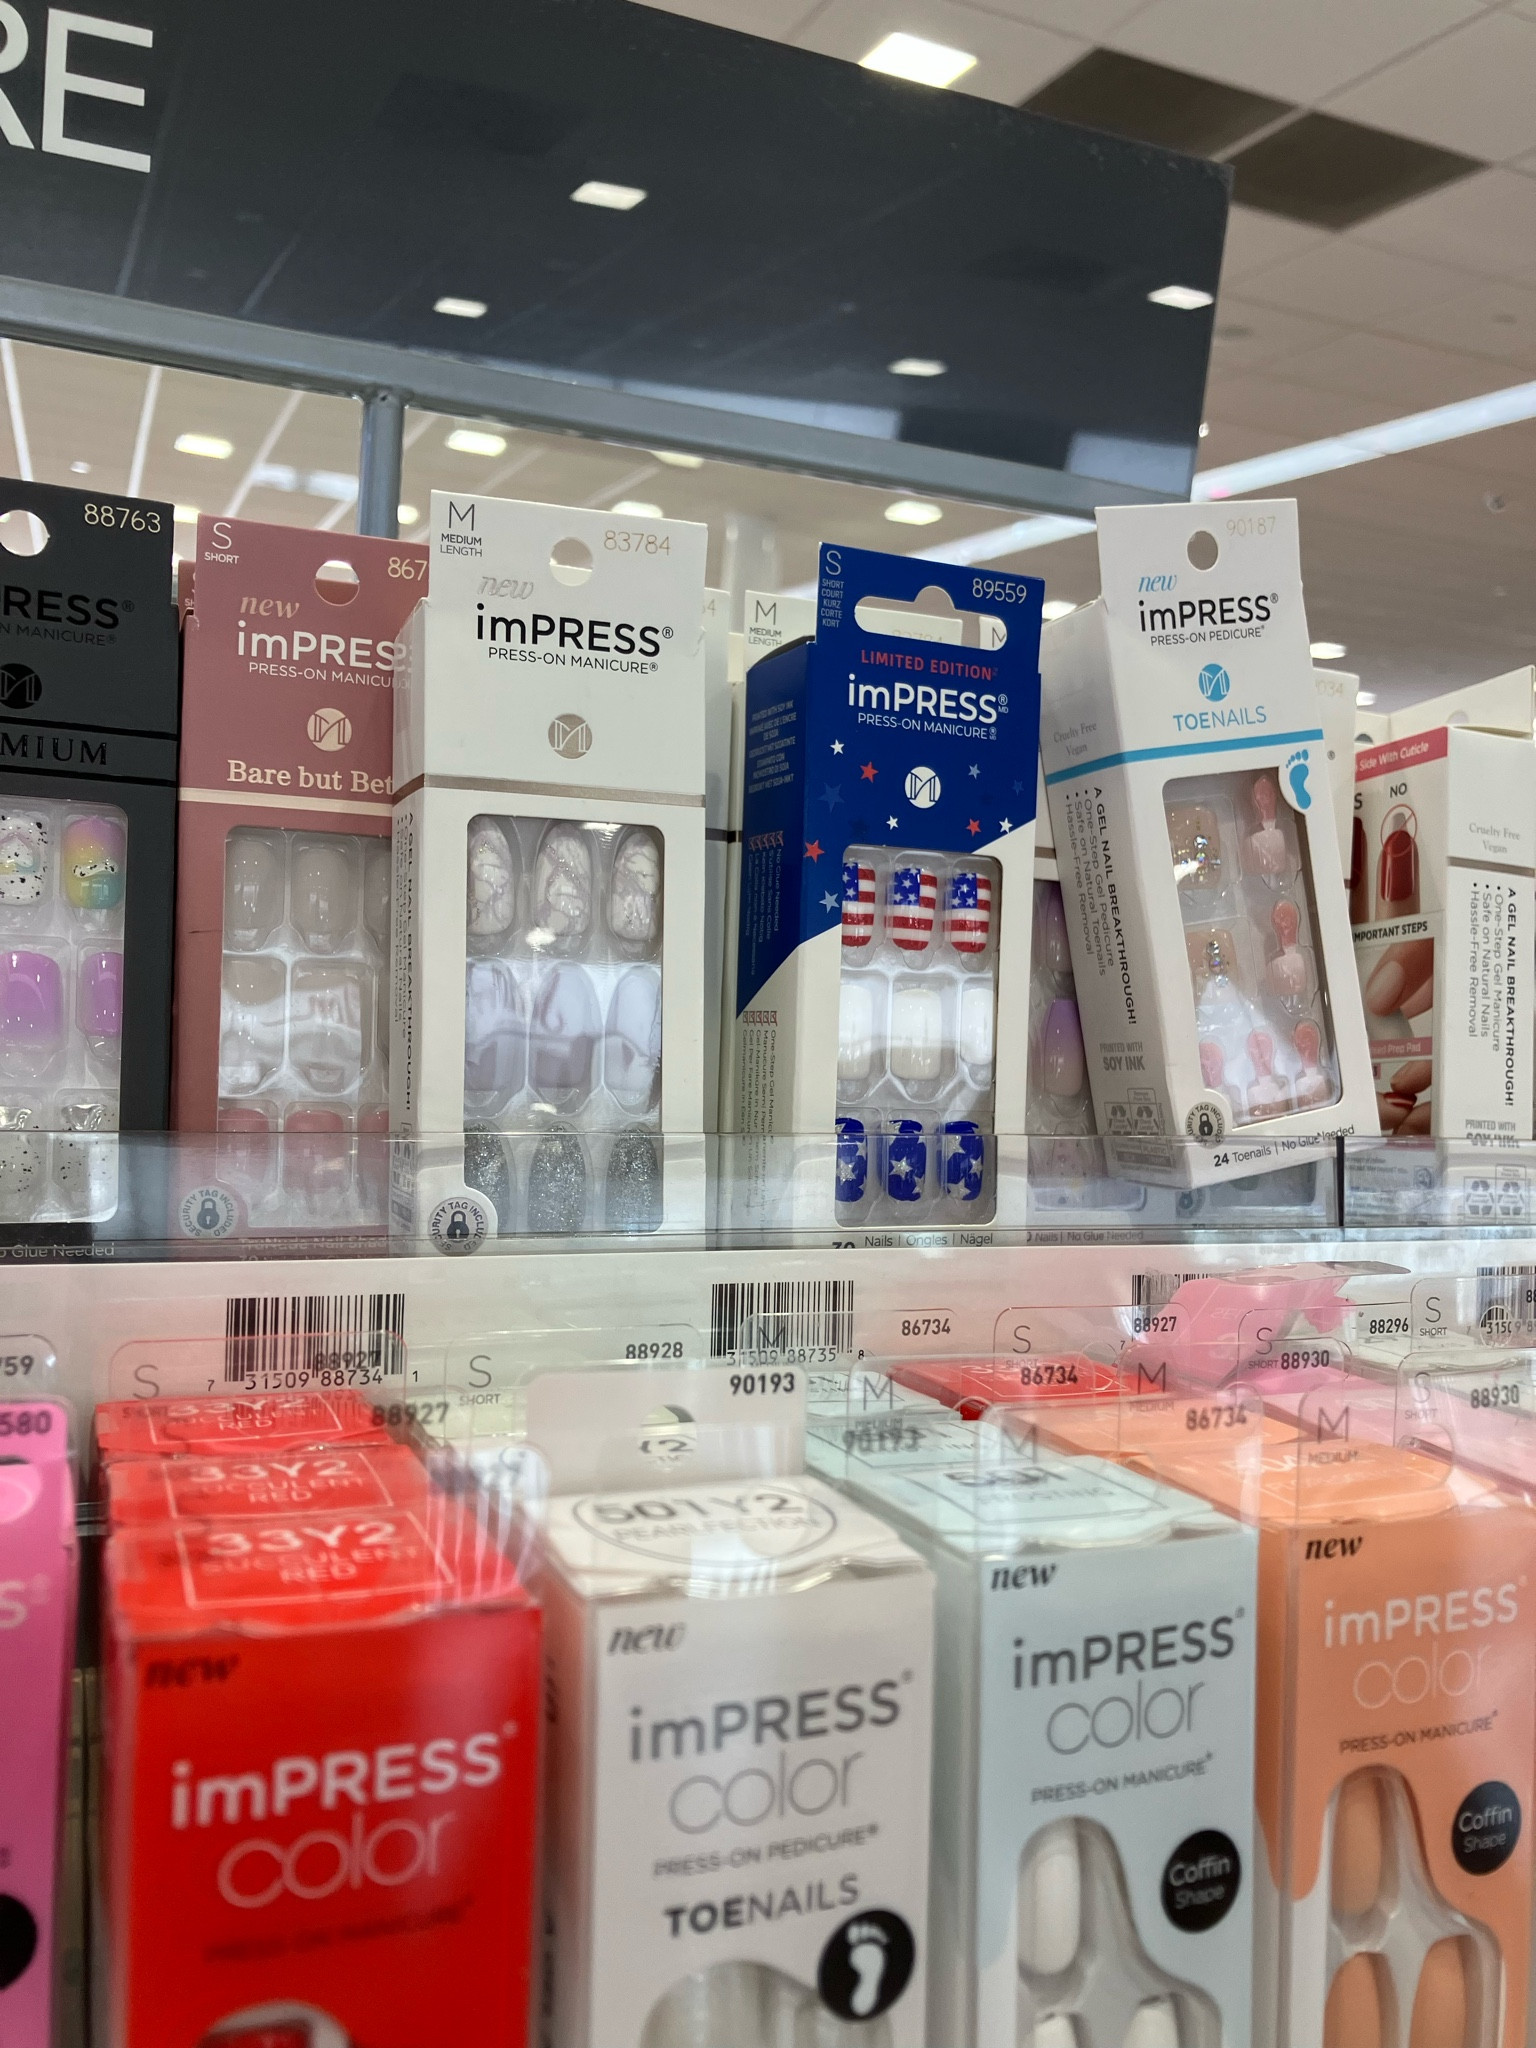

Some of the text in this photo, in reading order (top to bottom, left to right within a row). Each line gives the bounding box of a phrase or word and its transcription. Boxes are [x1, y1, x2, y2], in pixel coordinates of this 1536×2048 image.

[84, 503, 161, 533] 88763
[449, 500, 475, 531] M
[1226, 516, 1277, 537] 90187
[212, 522, 232, 549] S
[441, 533, 482, 546] MEDIUM
[604, 530, 670, 556] 83784
[204, 551, 239, 564] SHORT
[440, 544, 482, 557] LENGTH
[388, 557, 428, 582] 867
[825, 550, 842, 576] S
[477, 575, 534, 600] new
[821, 588, 844, 599] COURT
[822, 578, 844, 589] SHORT
[973, 578, 1027, 604] 89559
[1138, 574, 1177, 593] new
[239, 596, 300, 618] new
[755, 600, 776, 625] M
[821, 608, 843, 619] CORTE
[823, 598, 841, 609] KURZ
[749, 627, 781, 637] MEDIUM
[822, 618, 841, 628] KORT
[748, 637, 781, 647] LENGTH
[1150, 631, 1206, 647] PRESS-ON
[488, 647, 566, 667] PRESS-ON
[861, 650, 992, 680] LIMITED EDITION
[249, 662, 327, 681] PRESS-ON
[858, 713, 921, 732] PRESS-ON
[1173, 705, 1267, 732] TOENAILS
[1053, 722, 1097, 743] Cruelty Free
[1066, 743, 1088, 757] Vegan
[1360, 741, 1429, 772] Side With Cuticle
[227, 760, 394, 795] Bare but Bet
[1389, 782, 1408, 798] NO
[1469, 822, 1521, 841] Cruelty Free
[1483, 841, 1508, 854] Vegan
[1066, 803, 1094, 955] Hassle-Free Removal
[1074, 801, 1107, 976] Safe on Natural Toenails
[1084, 799, 1114, 967] One-Step Gel Pedicure
[1094, 787, 1136, 1024] A GEL NAIL BREAKTHROUGH!
[1401, 920, 1428, 935] STEPS
[1469, 891, 1480, 1037] Hassle-Free Removal
[1481, 892, 1492, 1037] Safe on Natural Nails
[1493, 894, 1504, 1052] One-Step Gel Manicure
[1505, 887, 1517, 1106] A GEL NAIL BREAKTHROUGH!
[1127, 1041, 1143, 1053] WITH
[1103, 1055, 1145, 1071] SOY INK
[1195, 1104, 1209, 1112] TAG
[1466, 1119, 1516, 1132] PRINTED WITH
[1214, 1140, 1296, 1167] 24 Toenails No
[182, 1190, 235, 1237] SECURITY TAG INCLUDED
[448, 1201, 468, 1210] TAG
[865, 1235, 893, 1247] Nails
[906, 1234, 947, 1248] Ongles
[960, 1232, 993, 1246] Nägel
[1035, 1231, 1058, 1243] Nails
[1067, 1230, 1082, 1241] No
[1084, 1230, 1104, 1242] Glue
[1107, 1229, 1144, 1241] Needed
[12, 1245, 48, 1258] Glue
[53, 1242, 115, 1258] Needed
[1425, 1296, 1441, 1323] S
[901, 1318, 951, 1337] 86734
[1134, 1316, 1177, 1333] 88927
[1369, 1317, 1410, 1335] 88296
[1419, 1326, 1448, 1337] SHORT
[626, 1342, 683, 1360] 88928
[1012, 1325, 1031, 1354] S
[1255, 1327, 1273, 1355] S
[787, 1347, 865, 1363] 88735 8
[1248, 1360, 1279, 1370] SHORT
[1281, 1350, 1330, 1371] 88930
[133, 1365, 160, 1399] S
[208, 1369, 418, 1391] 7 31509 88734 1
[468, 1355, 492, 1388] S
[730, 1372, 795, 1394] 90193
[1021, 1366, 1077, 1385] 86734
[1138, 1362, 1167, 1394] M
[459, 1393, 501, 1406] SHORT
[863, 1375, 893, 1410] M
[1470, 1384, 1520, 1409] 88930
[218, 1419, 273, 1431] RED
[371, 1403, 449, 1427] 88927
[1186, 1405, 1248, 1431] 86734
[1317, 1406, 1350, 1444] M
[190, 1459, 353, 1483] 33Y2
[249, 1489, 312, 1503] RED
[206, 1521, 398, 1557] 33Y2
[1305, 1535, 1364, 1561] new
[279, 1562, 357, 1586] RED
[990, 1563, 1059, 1593] new
[607, 1622, 686, 1657] new
[1354, 1640, 1492, 1710] color
[1046, 1679, 1206, 1756] color
[1339, 1731, 1416, 1754] PRESS-ON
[668, 1750, 866, 1836] color
[1030, 1776, 1118, 1806] PRESS-ON
[1458, 1804, 1513, 1834] Coffin
[1463, 1831, 1507, 1855] Shape
[217, 1810, 457, 1910] color
[652, 1846, 761, 1878] PRESS-ON
[1168, 1853, 1232, 1888] Coffin
[663, 1872, 860, 1938] TOENAILS
